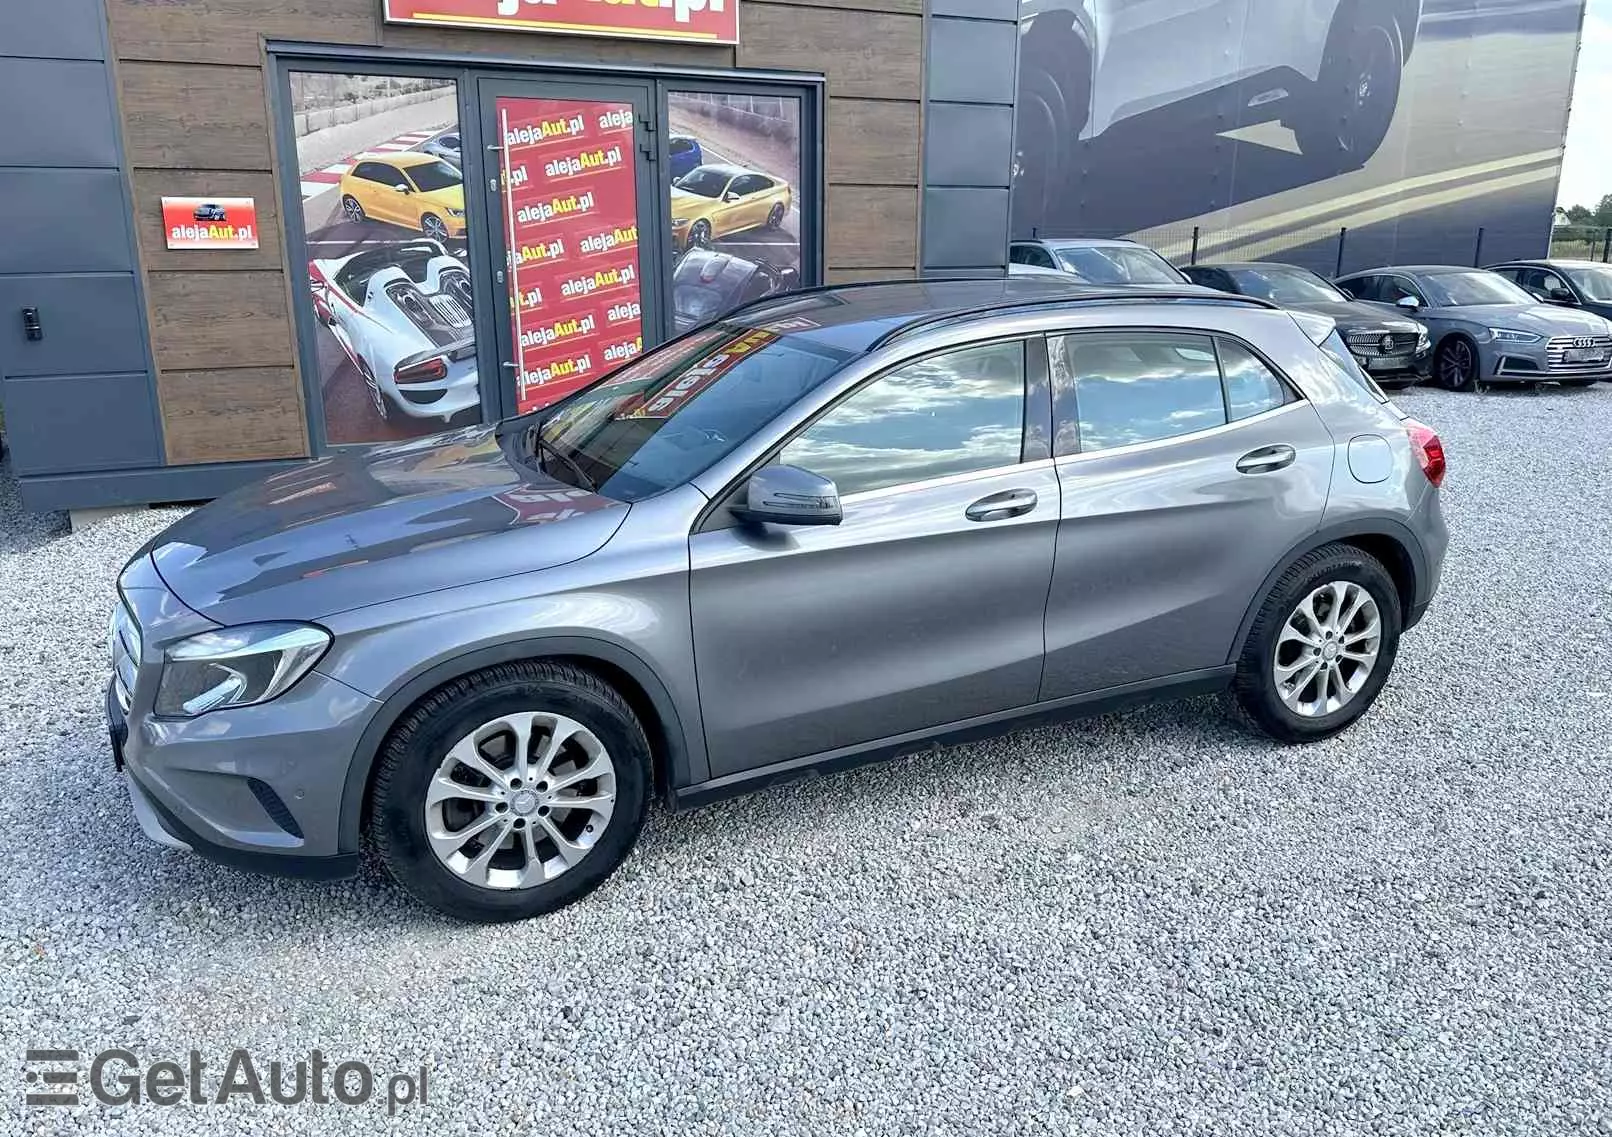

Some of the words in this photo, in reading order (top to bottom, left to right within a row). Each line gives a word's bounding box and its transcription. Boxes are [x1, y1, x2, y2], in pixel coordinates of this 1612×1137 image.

[506, 114, 585, 145] alejaAut.pl
[545, 146, 622, 176] alejaAut.pl
[516, 191, 594, 222] alejaAut.pl
[171, 224, 253, 241] alejaAut.pl
[561, 264, 635, 295] alejaAut.pl
[521, 315, 595, 346] alejaAut.pl
